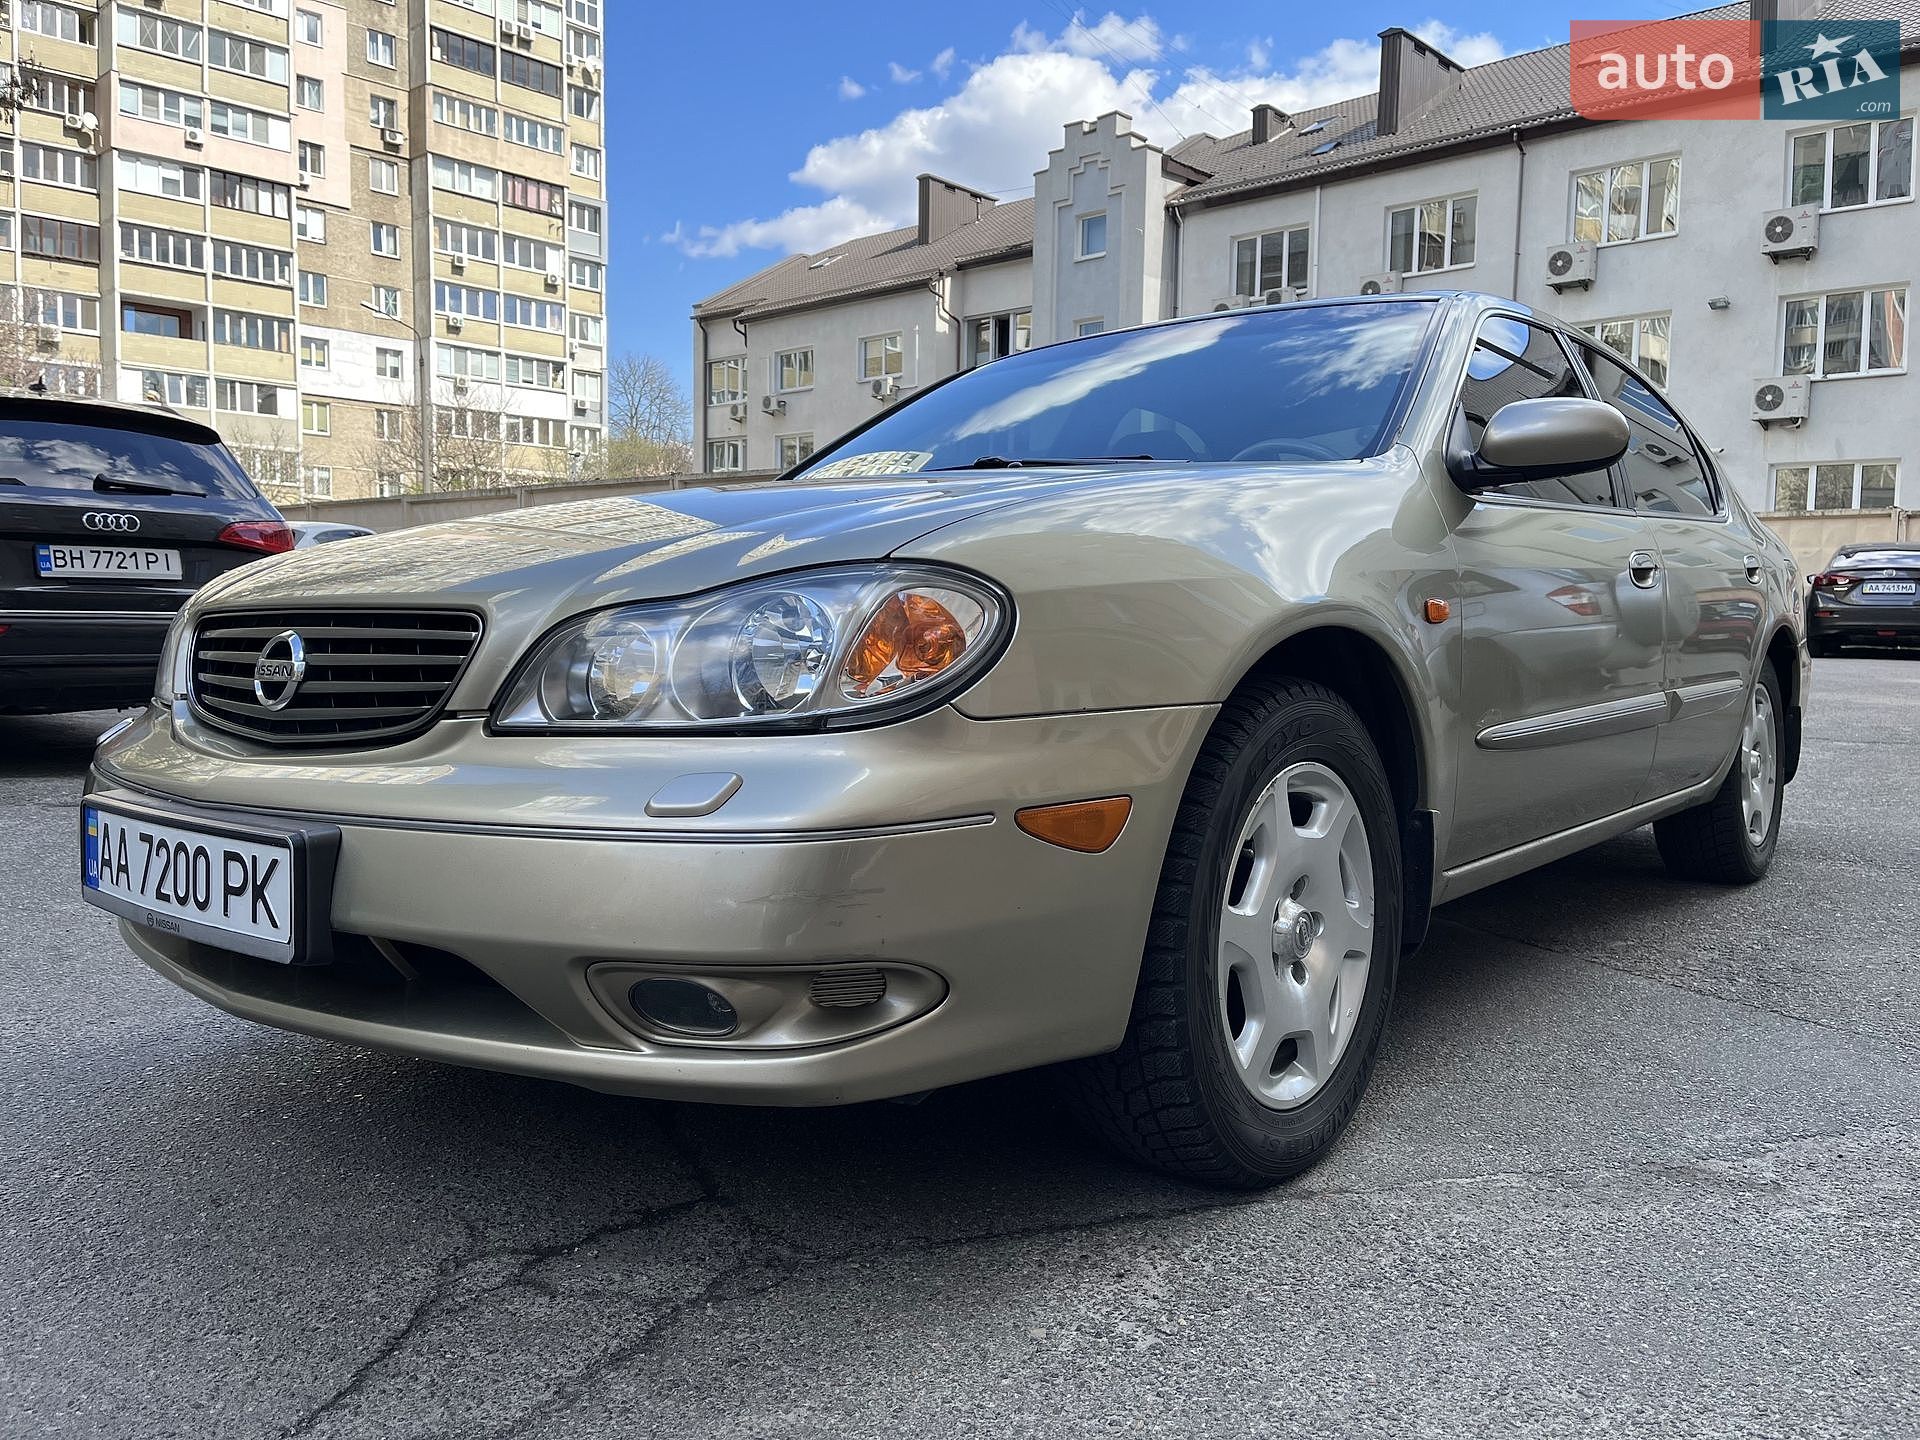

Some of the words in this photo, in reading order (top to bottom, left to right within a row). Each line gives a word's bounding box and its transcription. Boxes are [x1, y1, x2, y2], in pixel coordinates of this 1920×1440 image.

[40, 560, 51, 569] UA
[52, 549, 85, 569] BH
[90, 550, 140, 570] 7721
[146, 551, 171, 572] PI
[1868, 584, 1880, 592] AA
[1901, 584, 1913, 592] MA
[256, 664, 293, 677] ISSAN
[88, 858, 99, 878] UA
[99, 822, 131, 891] AA
[138, 831, 211, 911] 7200
[222, 849, 280, 929] PK
[155, 915, 180, 933] NISSAN
